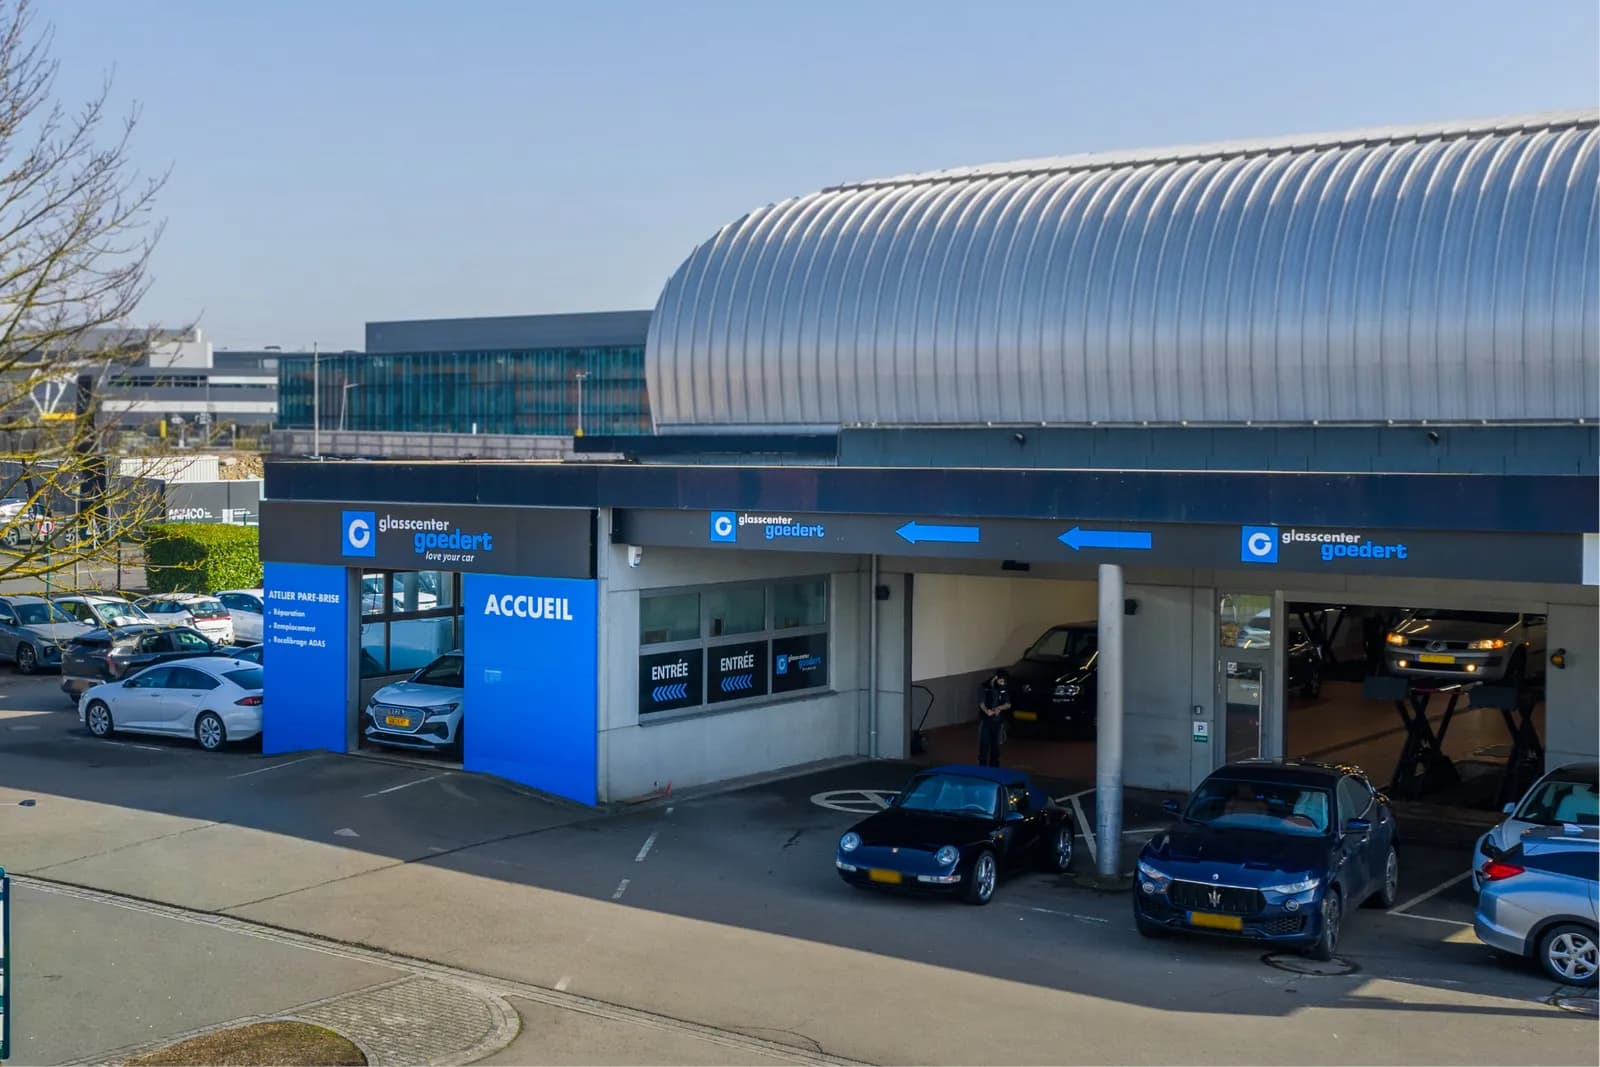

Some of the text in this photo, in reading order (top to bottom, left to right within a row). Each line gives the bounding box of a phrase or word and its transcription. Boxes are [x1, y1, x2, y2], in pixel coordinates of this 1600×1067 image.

[378, 514, 450, 532] glasscenter
[738, 513, 793, 526] glasscenter
[765, 522, 825, 539] goedert
[1281, 529, 1361, 544] glasscenter
[414, 528, 493, 553] goedert
[425, 550, 475, 563] love your car
[1320, 541, 1408, 561] goedert
[268, 590, 340, 604] ATELIER PARE-BRISE
[484, 593, 574, 621] ACCUEIL
[308, 640, 326, 648] ADAS
[651, 658, 689, 681] ENTRÉE
[720, 650, 754, 672] ENTRÉE
